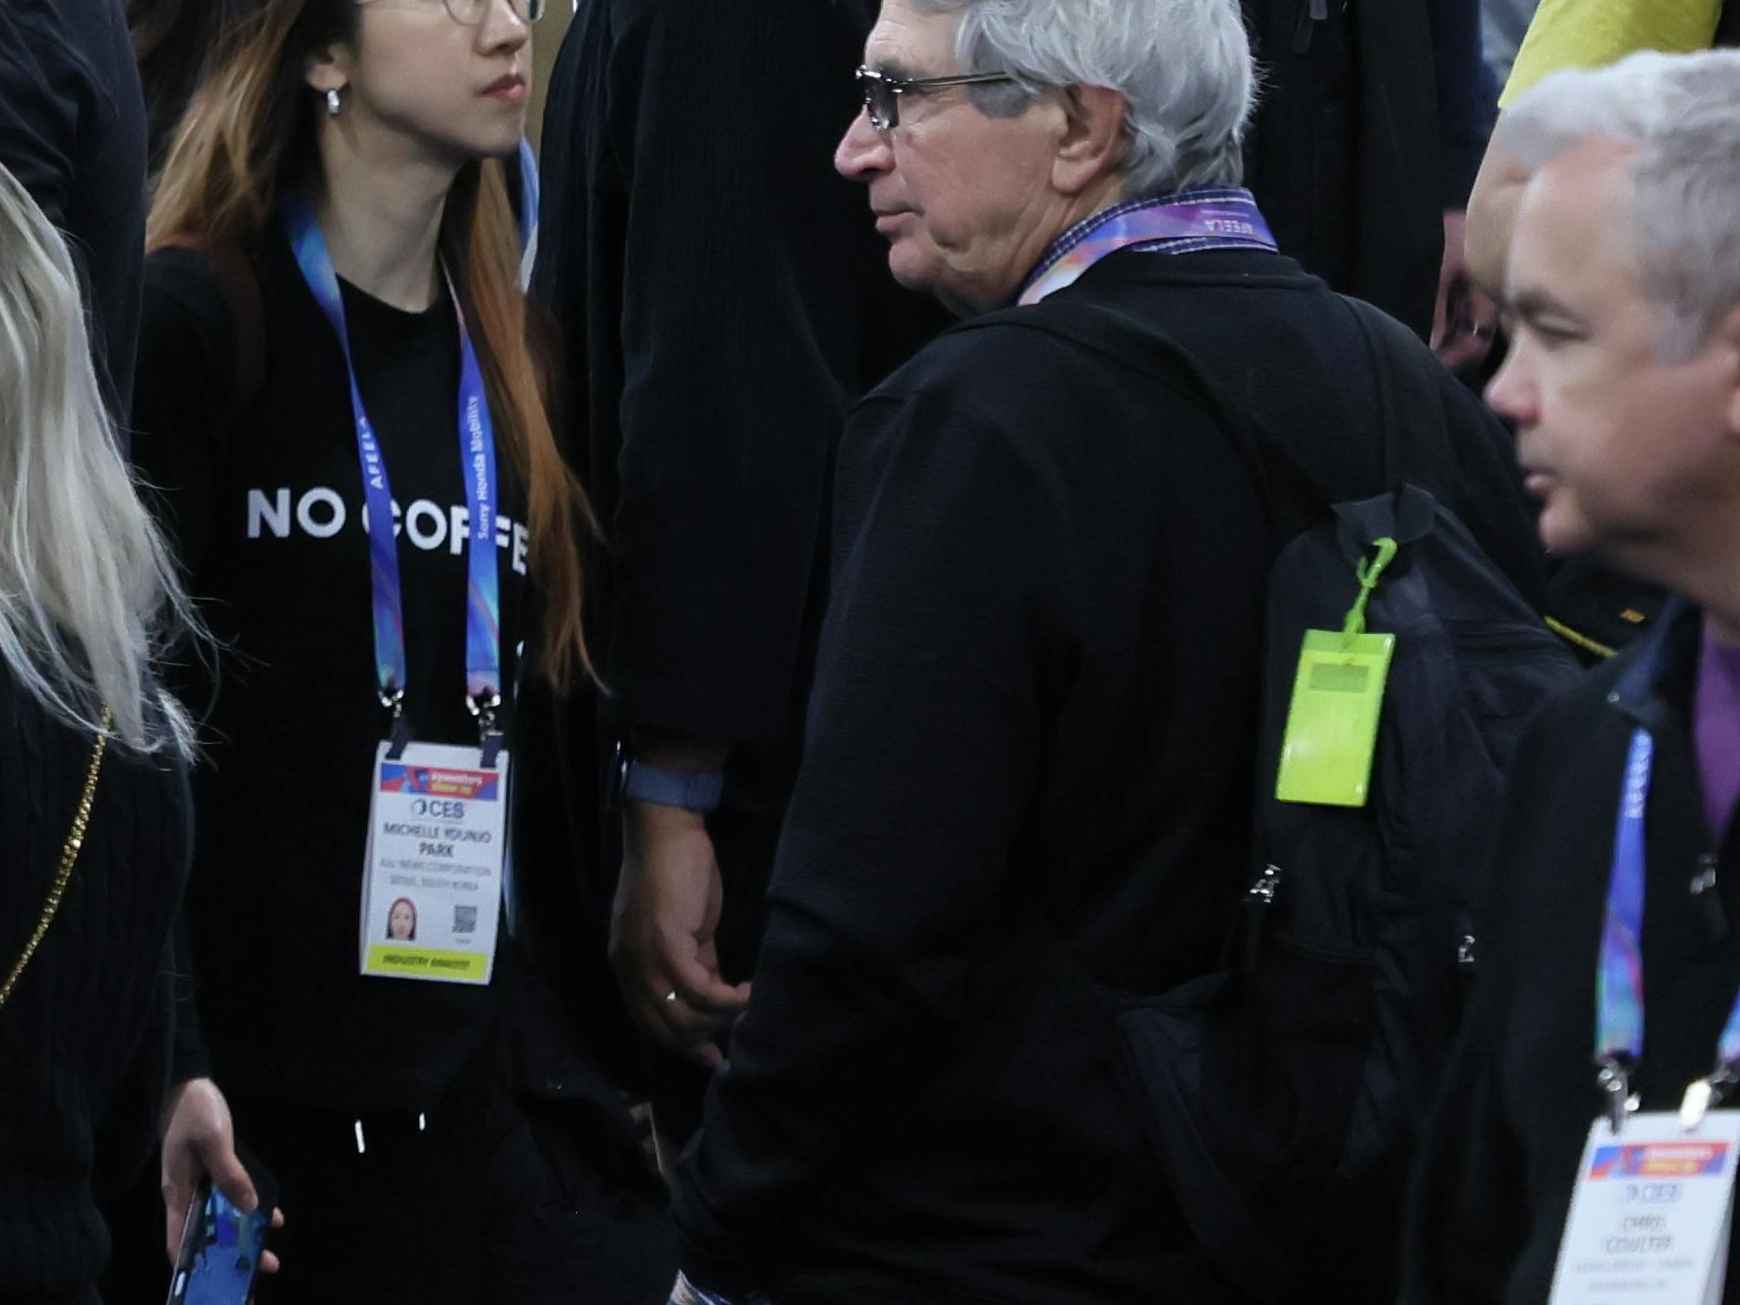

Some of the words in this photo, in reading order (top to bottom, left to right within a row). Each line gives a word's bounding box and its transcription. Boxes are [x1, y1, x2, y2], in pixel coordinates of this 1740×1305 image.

[466, 395, 479, 453] Mobility
[473, 454, 489, 501] Honda
[247, 487, 346, 538] NO
[477, 503, 491, 540] Sony
[429, 800, 466, 819] CES
[419, 842, 455, 858] PARK
